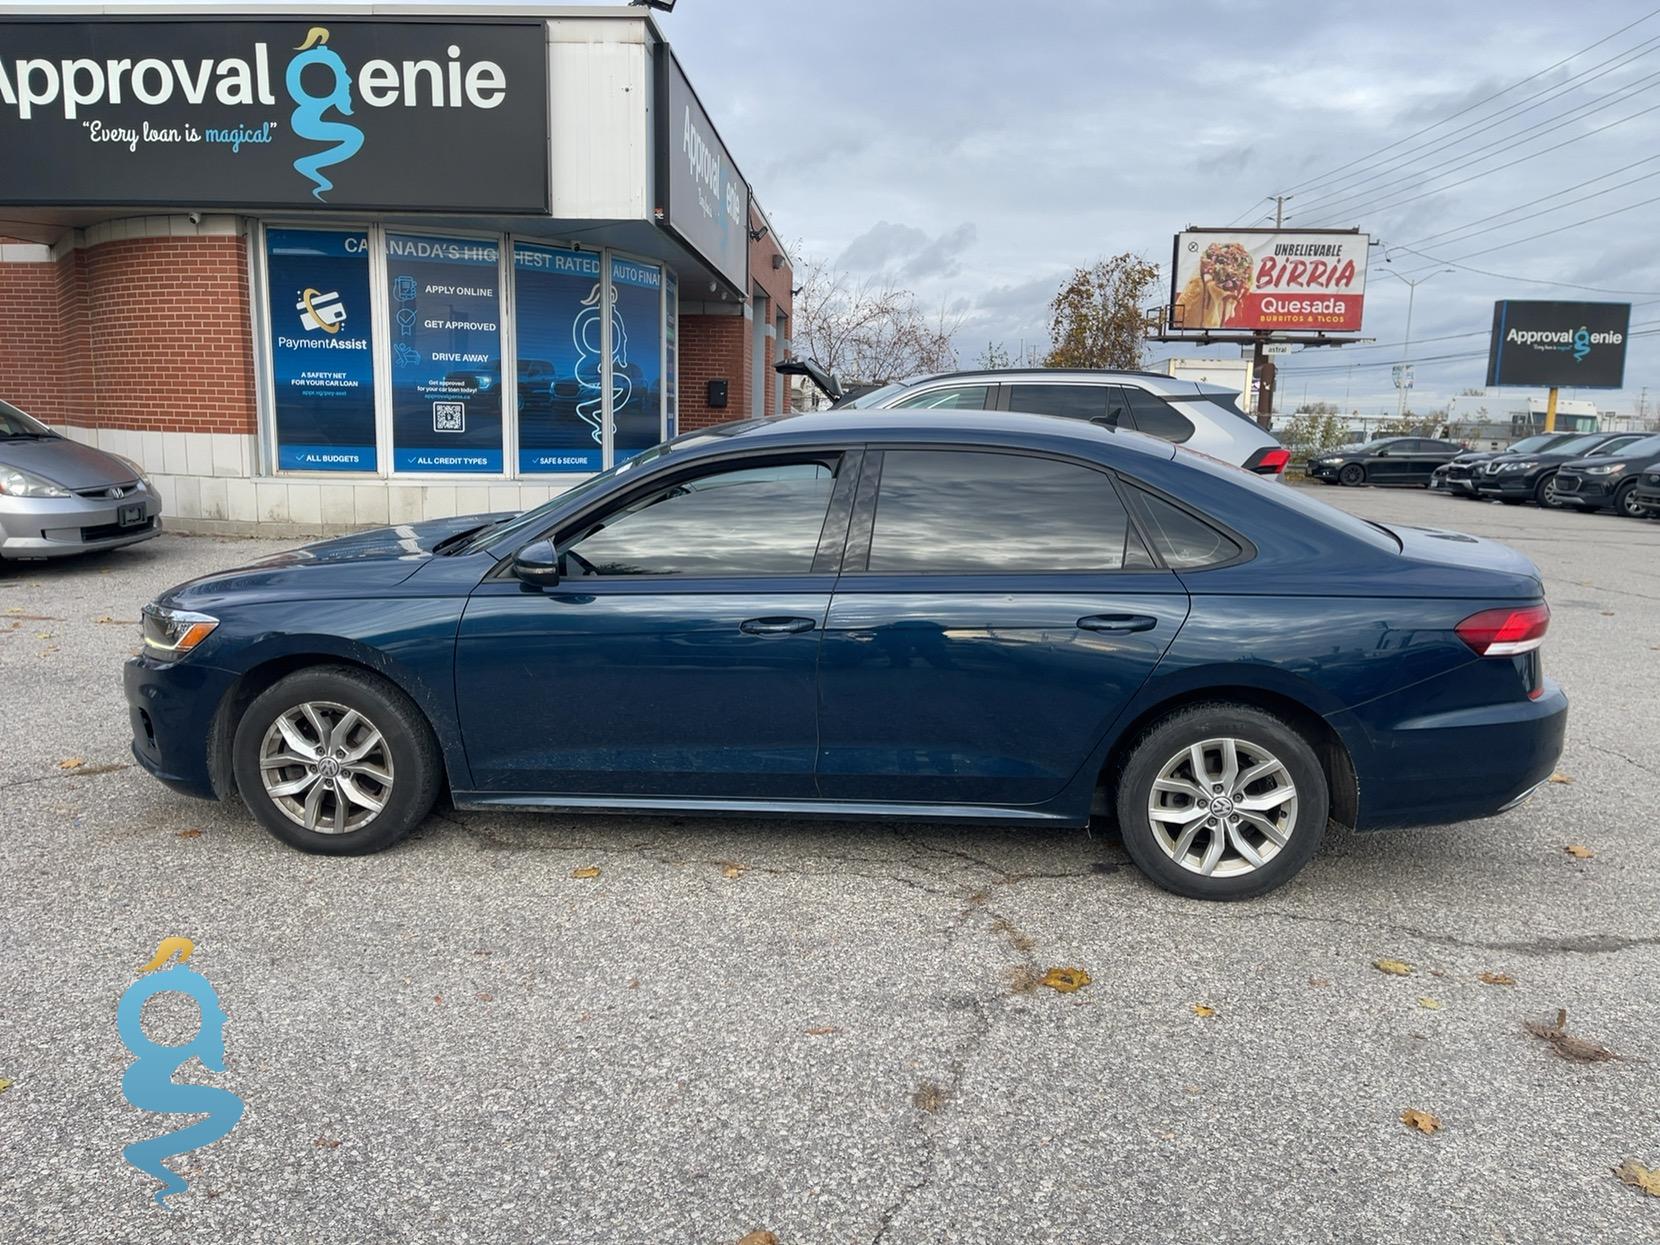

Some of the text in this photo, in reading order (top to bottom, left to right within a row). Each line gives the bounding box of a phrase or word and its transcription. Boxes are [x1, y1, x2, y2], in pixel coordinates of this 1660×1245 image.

[143, 121, 181, 143] loan
[185, 123, 201, 143] is
[1274, 243, 1343, 257] UNBELIEVABLE
[555, 255, 600, 274] RATED
[613, 265, 638, 281] AUTO
[425, 285, 493, 297] APPLY ONLINE
[1260, 297, 1346, 314] Quesada
[424, 320, 496, 331] GET APPROVED
[278, 336, 367, 350] PaymentAssist
[1506, 328, 1573, 345] Approval
[432, 352, 488, 363] DRIVE AWAY
[322, 455, 359, 463] BUDGETS
[433, 457, 463, 465] CREDIT
[464, 457, 488, 465] TYPES
